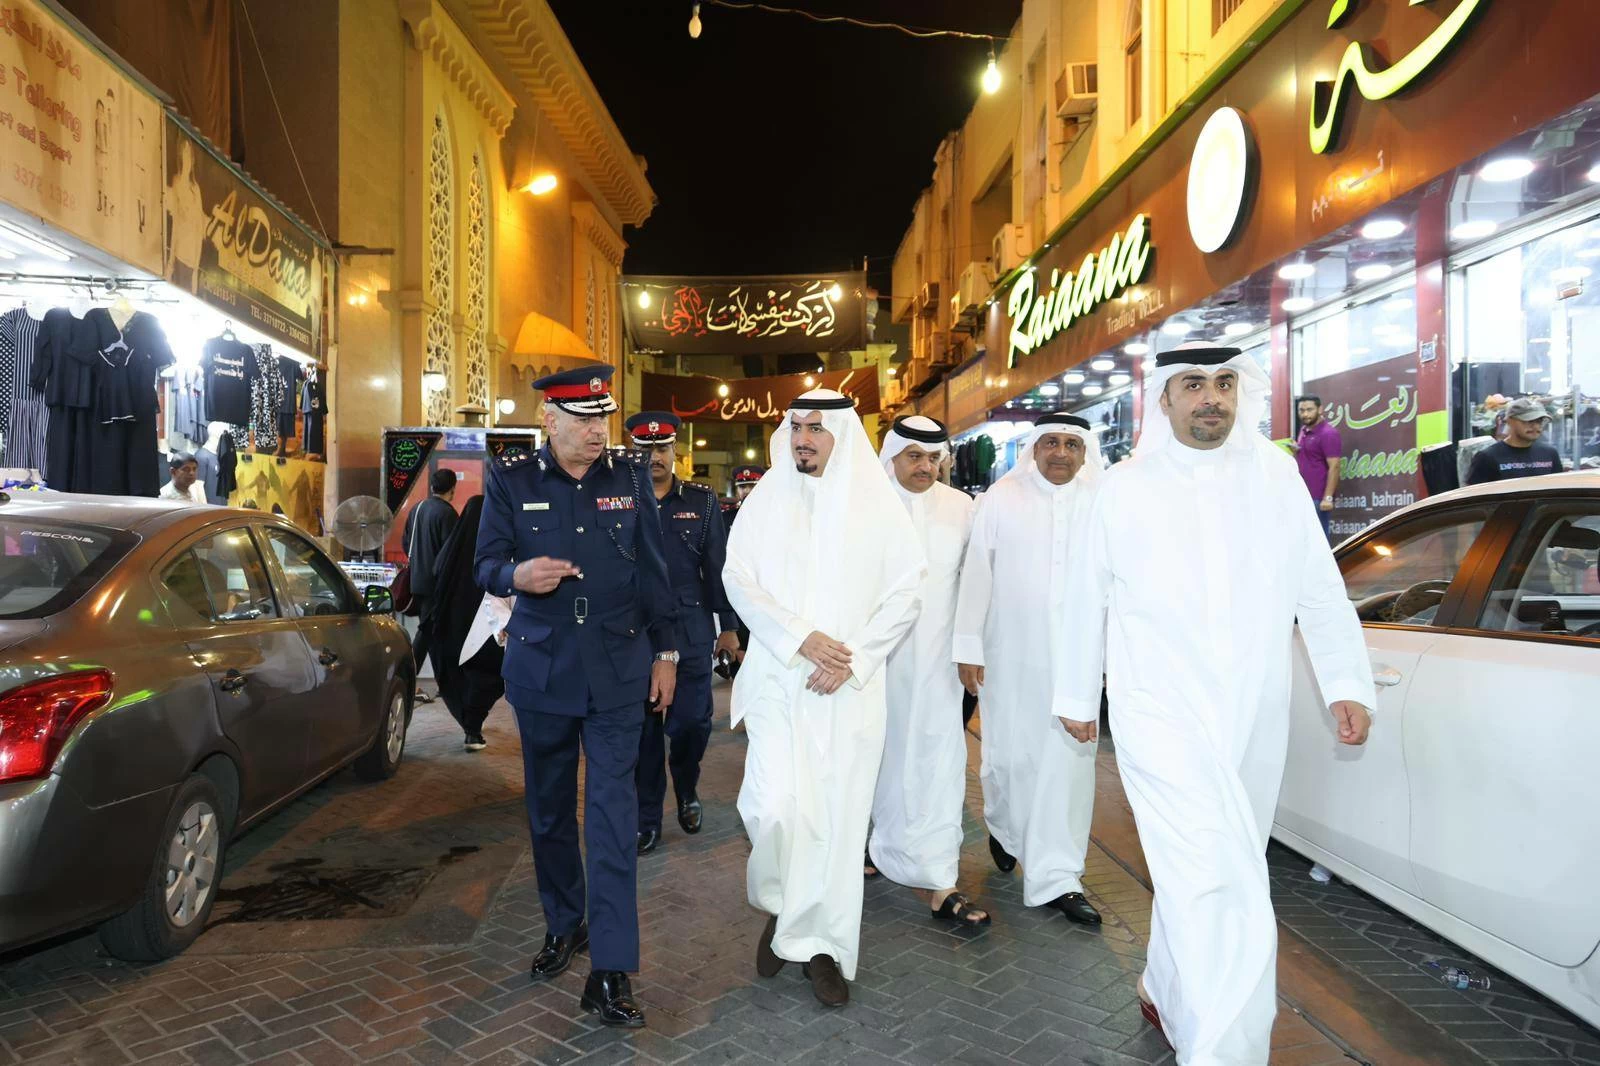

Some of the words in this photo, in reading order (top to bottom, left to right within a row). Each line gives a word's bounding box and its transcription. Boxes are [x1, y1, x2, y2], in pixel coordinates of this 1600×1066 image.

[13, 66, 82, 143] Tailoring
[1007, 213, 1150, 369] Raiaana
[1106, 308, 1136, 335] Trading
